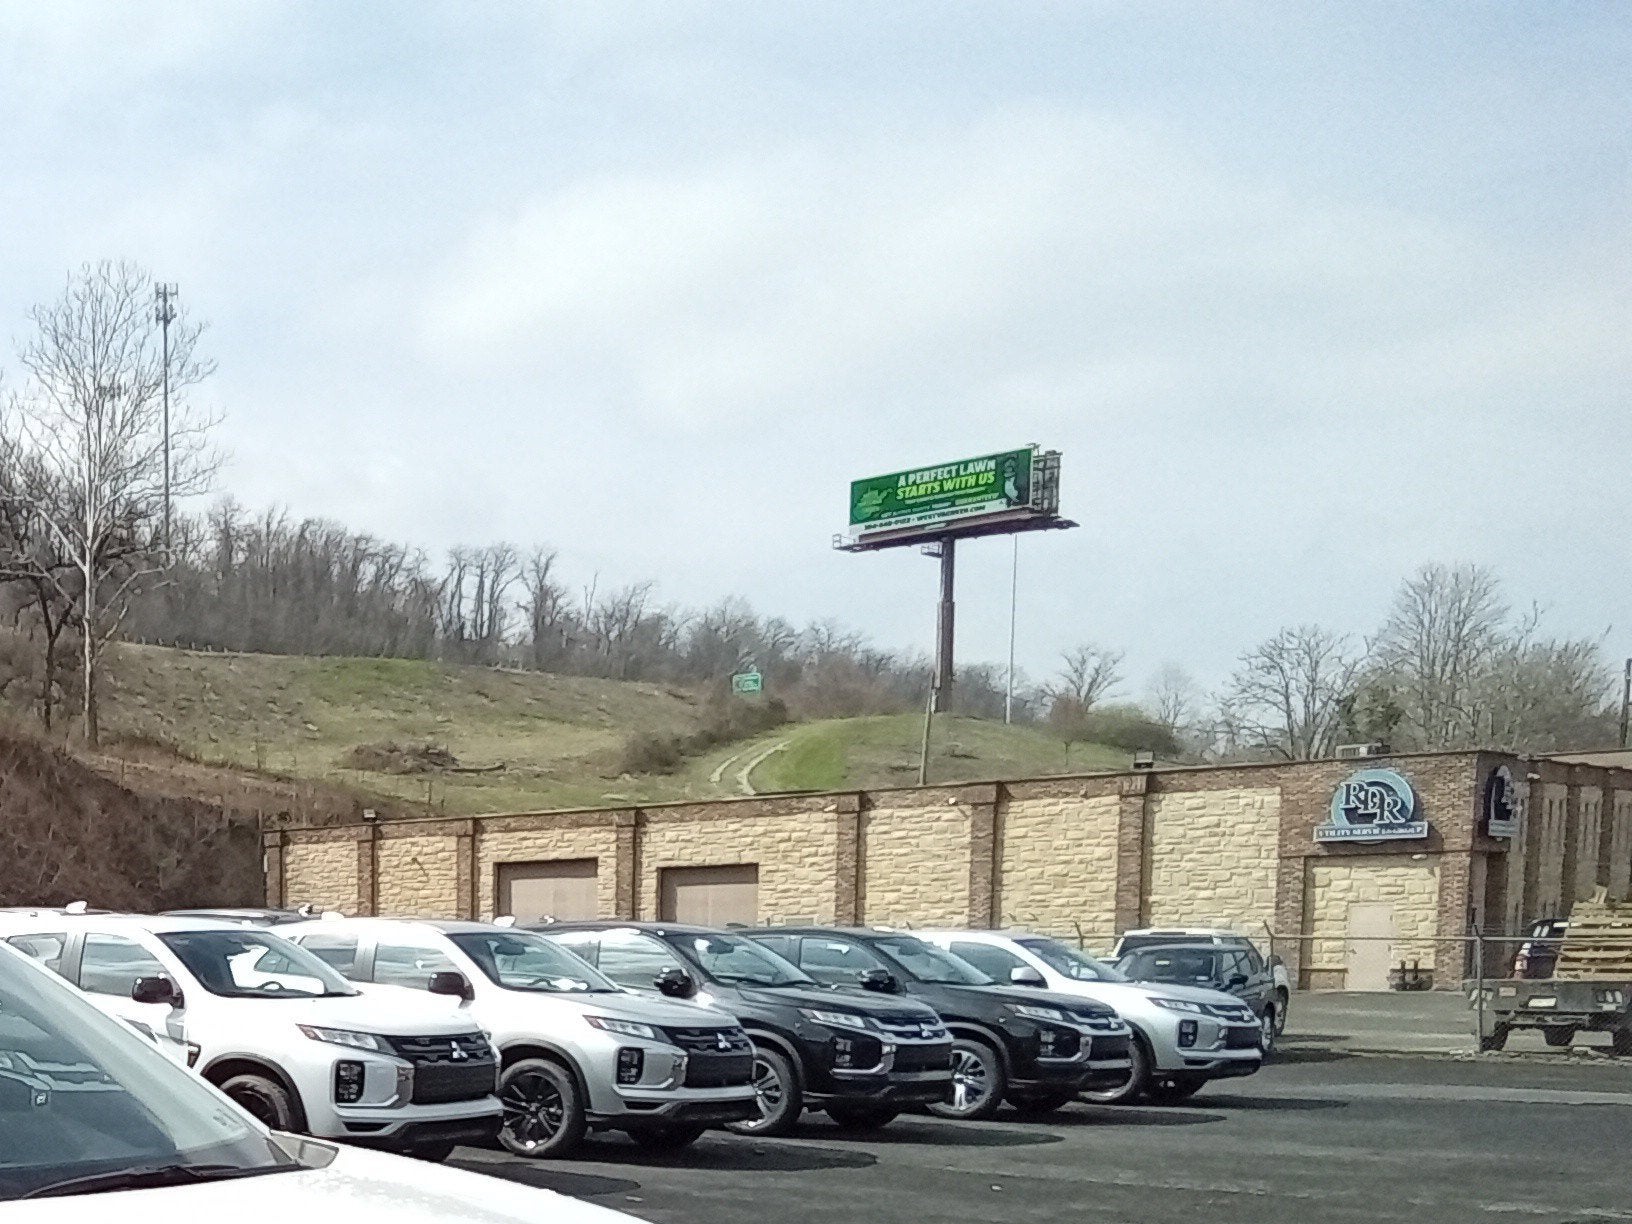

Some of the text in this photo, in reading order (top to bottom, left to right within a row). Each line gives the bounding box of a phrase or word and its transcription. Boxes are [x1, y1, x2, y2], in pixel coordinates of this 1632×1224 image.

[896, 481, 941, 500] STARTS
[942, 474, 977, 490] WITH
[977, 471, 995, 485] US
[898, 459, 996, 487] A PERFECT LAWN
[1339, 781, 1406, 824] RDR
